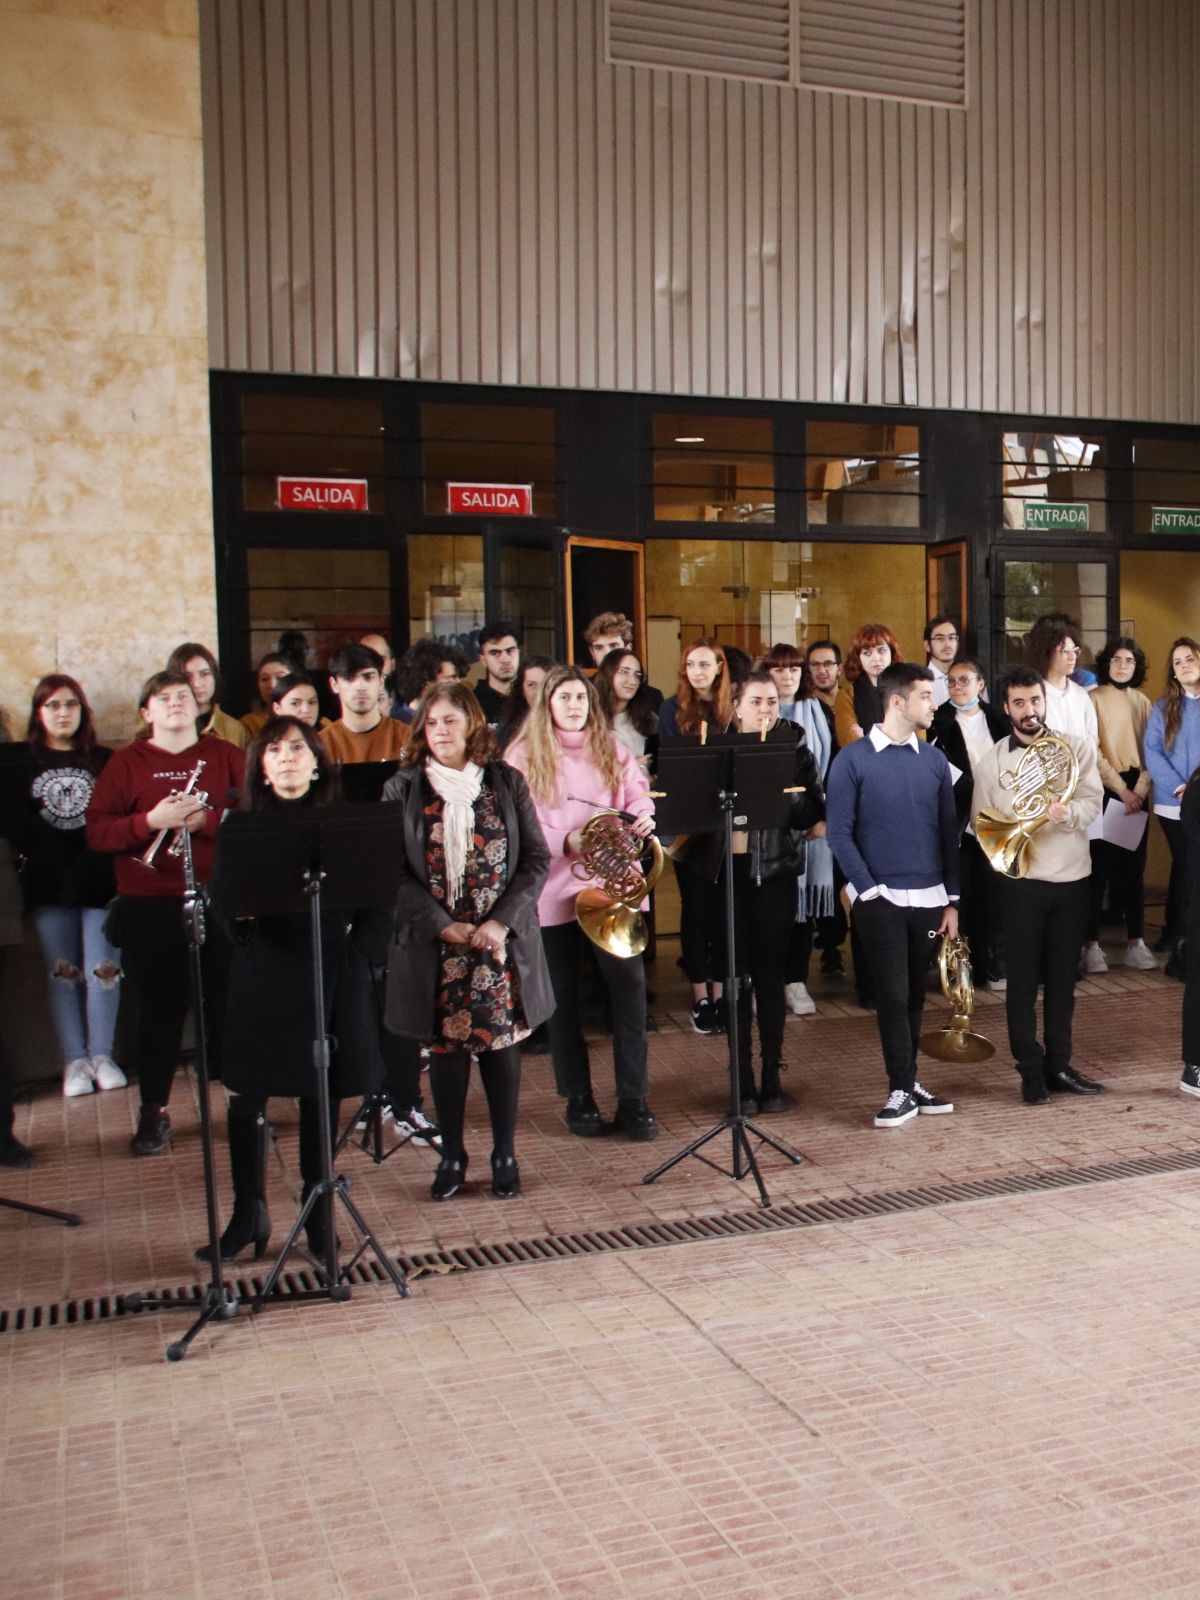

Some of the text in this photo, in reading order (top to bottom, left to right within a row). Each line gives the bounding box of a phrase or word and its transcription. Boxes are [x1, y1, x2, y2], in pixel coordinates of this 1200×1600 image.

[292, 486, 355, 503] SALIDA
[461, 491, 520, 508] SALIDA
[1026, 508, 1087, 522] ENTRADA
